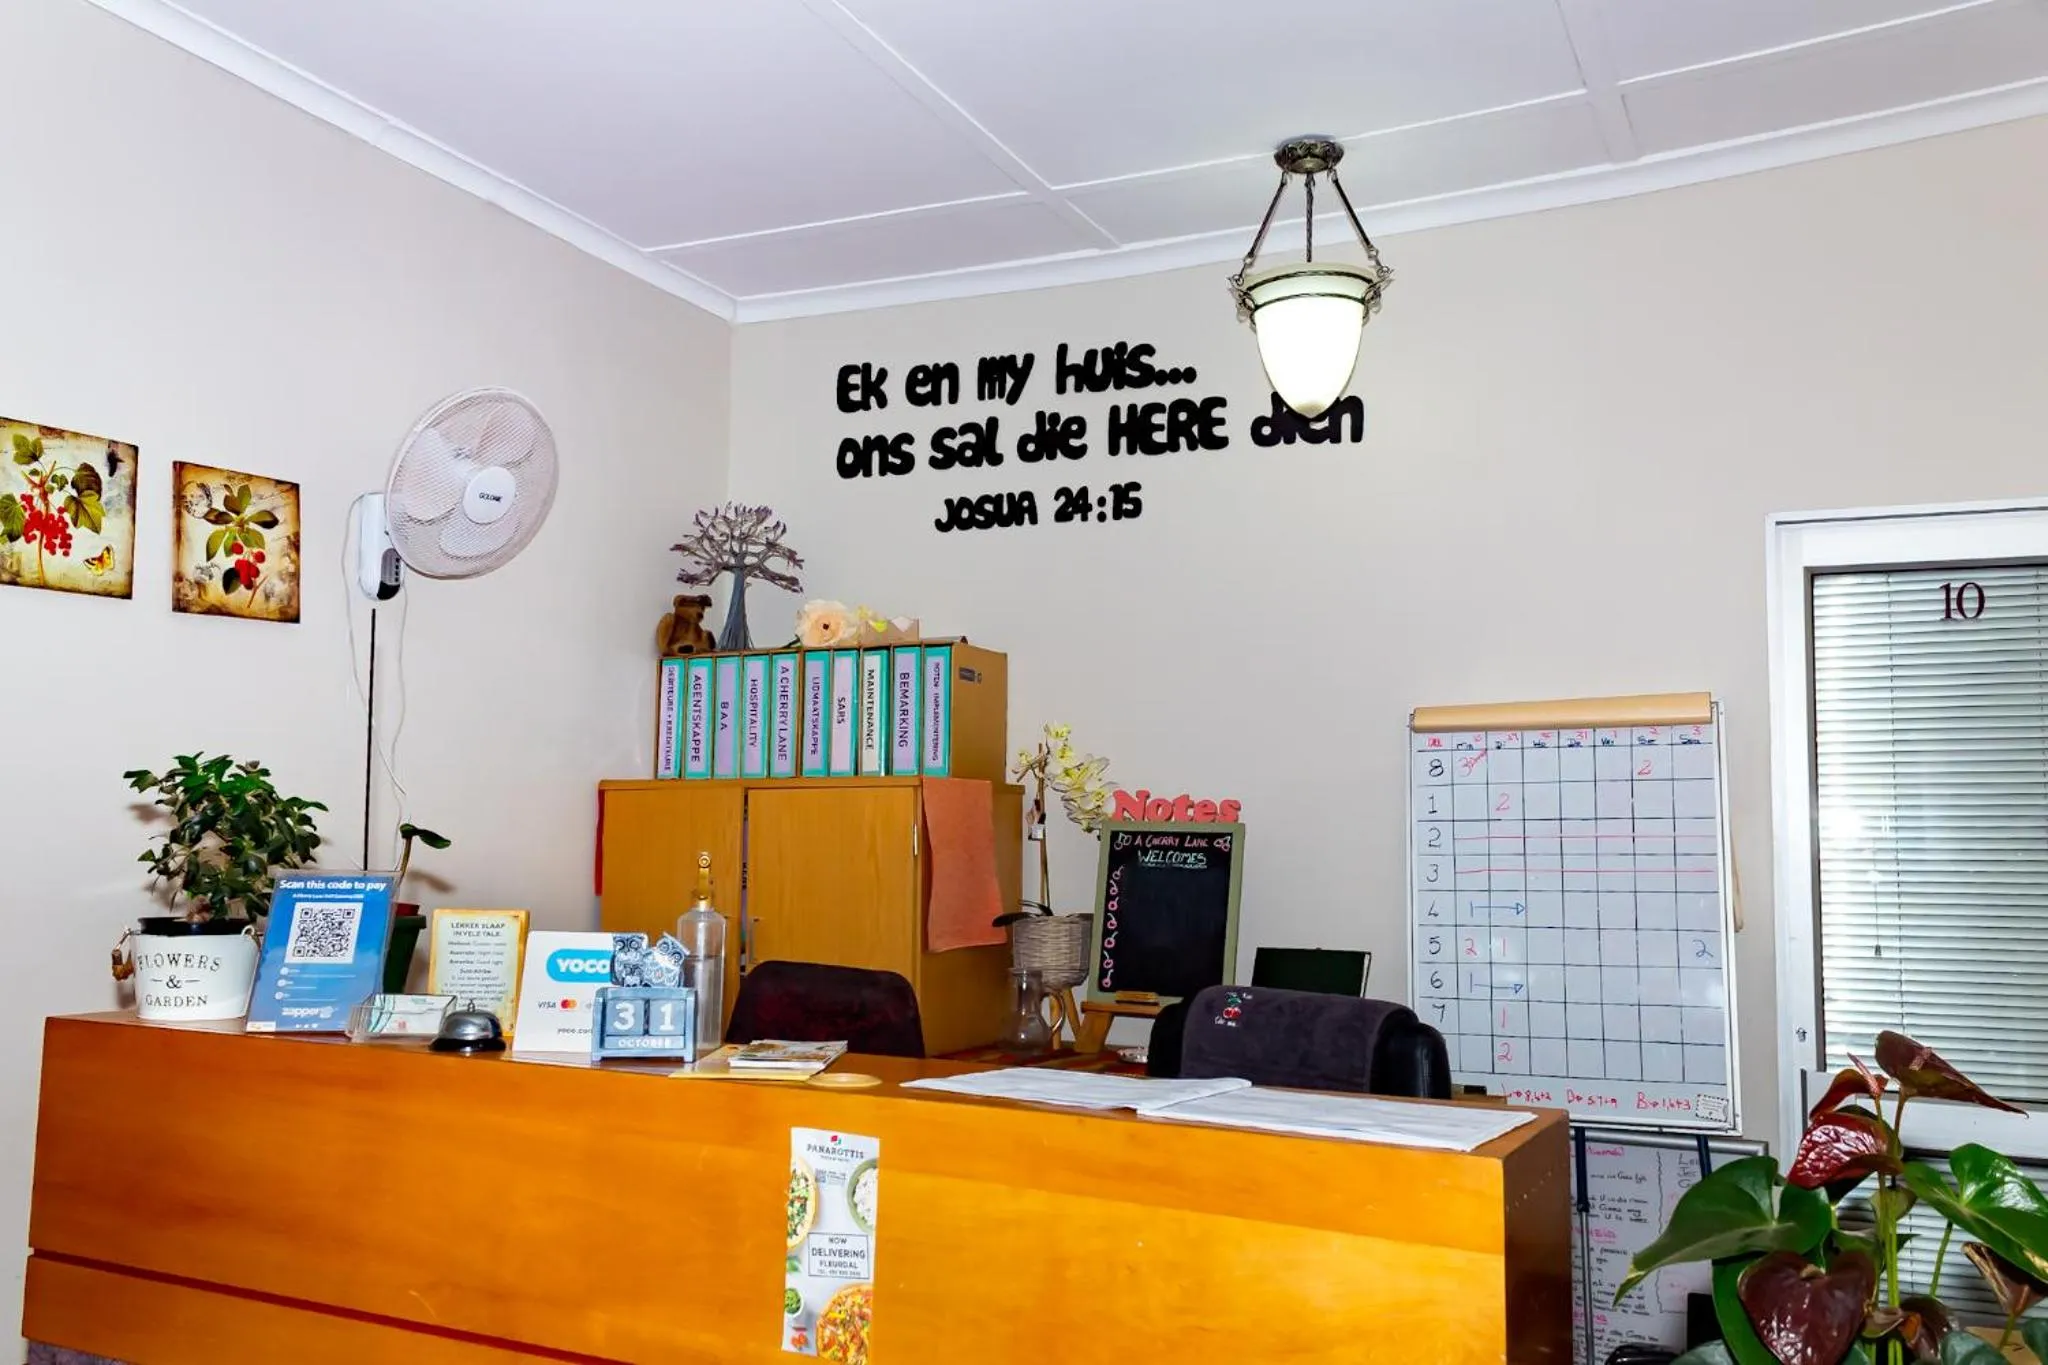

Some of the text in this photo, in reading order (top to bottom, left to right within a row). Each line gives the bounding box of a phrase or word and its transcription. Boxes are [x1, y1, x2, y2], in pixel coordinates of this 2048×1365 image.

[836, 341, 1197, 413] Ek en my huis...
[836, 391, 1364, 479] ons sal die HERE dien
[935, 481, 1143, 533] JOSUA 24:15
[1939, 582, 1985, 620] 10
[691, 674, 702, 762] AGENTSKAPPE
[748, 679, 758, 747] HOSPITALITY
[778, 666, 789, 761] A CHERRY LANE
[811, 676, 820, 756] LIDMAATSKAPPE
[837, 697, 846, 724] SARS
[865, 669, 874, 750] MAINTENANCE
[898, 672, 909, 748] BEMARKING
[1429, 759, 1444, 777] 8
[1637, 760, 1652, 775] 2
[1113, 789, 1241, 823] Notes
[1429, 795, 1437, 814] 1
[1495, 793, 1510, 811] 2
[1134, 835, 1142, 846] A
[1428, 828, 1441, 848] 2
[1138, 850, 1206, 864] WELCOMES
[1427, 864, 1439, 883] 3
[280, 880, 386, 891] Scan this code to pay
[1429, 936, 1441, 954] 5
[1464, 938, 1477, 956] 2
[1692, 940, 1714, 958] 2
[137, 952, 222, 972] FLOWERS
[556, 957, 610, 974] YOCO
[1430, 971, 1443, 989] 6
[145, 994, 208, 1008] GARDEN
[538, 1001, 556, 1009] VISA
[613, 1002, 675, 1030] 3 1
[1432, 1004, 1445, 1022] 7
[618, 1038, 671, 1048] OCTOBER
[1497, 1042, 1513, 1062] 2
[807, 1144, 864, 1159] PANAROTTIS
[811, 1248, 865, 1259] DELIVERING
